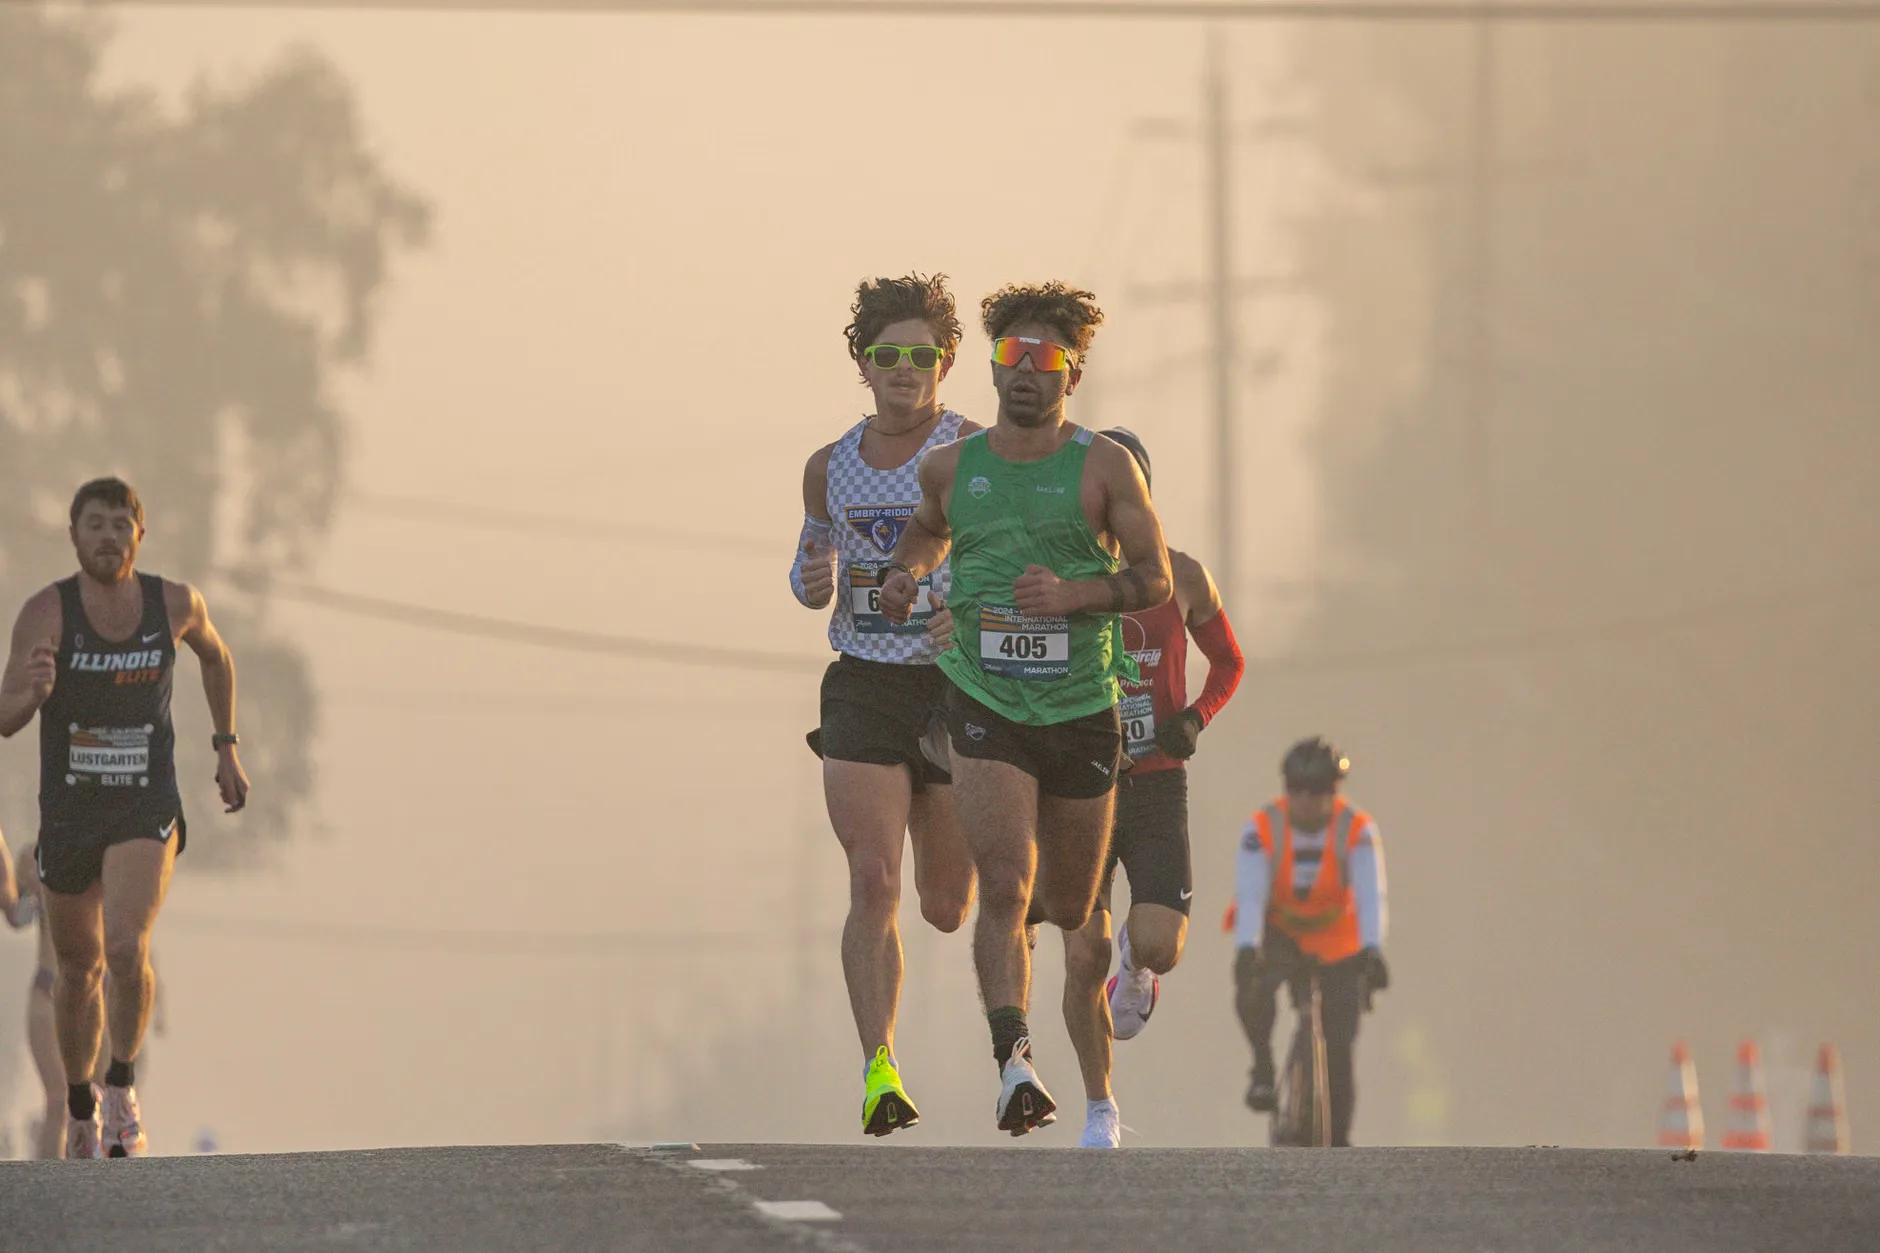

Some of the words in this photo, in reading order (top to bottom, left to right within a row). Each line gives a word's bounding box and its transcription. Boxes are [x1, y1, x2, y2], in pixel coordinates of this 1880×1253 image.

[992, 606, 1013, 614] 2024
[1004, 615, 1068, 623] INTERNATIONAL
[1021, 623, 1068, 631] MARATHON
[1000, 635, 1047, 659] 405
[70, 650, 161, 671] ILLINOIS
[115, 669, 160, 684] ELITE
[72, 751, 147, 765] LUSTGARTEN
[101, 774, 133, 786] ELITE
